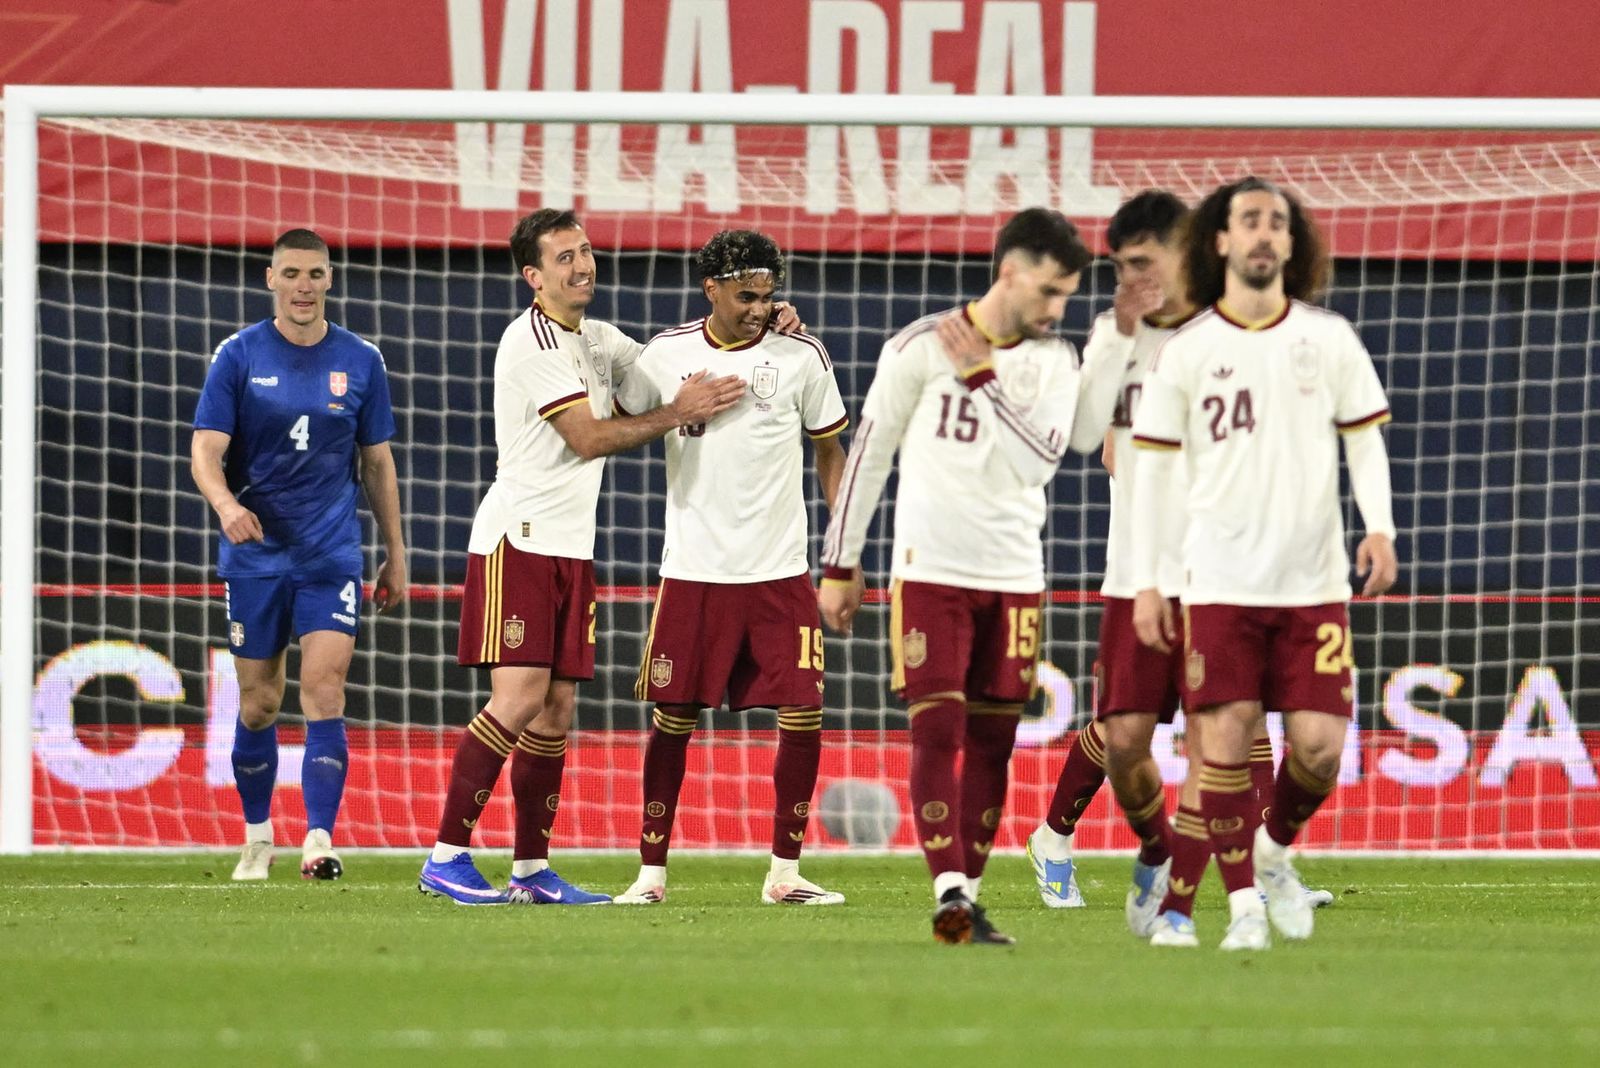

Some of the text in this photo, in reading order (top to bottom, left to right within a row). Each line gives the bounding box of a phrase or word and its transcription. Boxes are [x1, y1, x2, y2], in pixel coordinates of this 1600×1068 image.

[447, 0, 1121, 215] VILA-REAL
[290, 414, 310, 450] 4
[936, 394, 979, 443] 15
[1202, 388, 1256, 443] 24
[340, 580, 357, 615] 4
[798, 625, 825, 670] 19
[1006, 606, 1038, 659] 15
